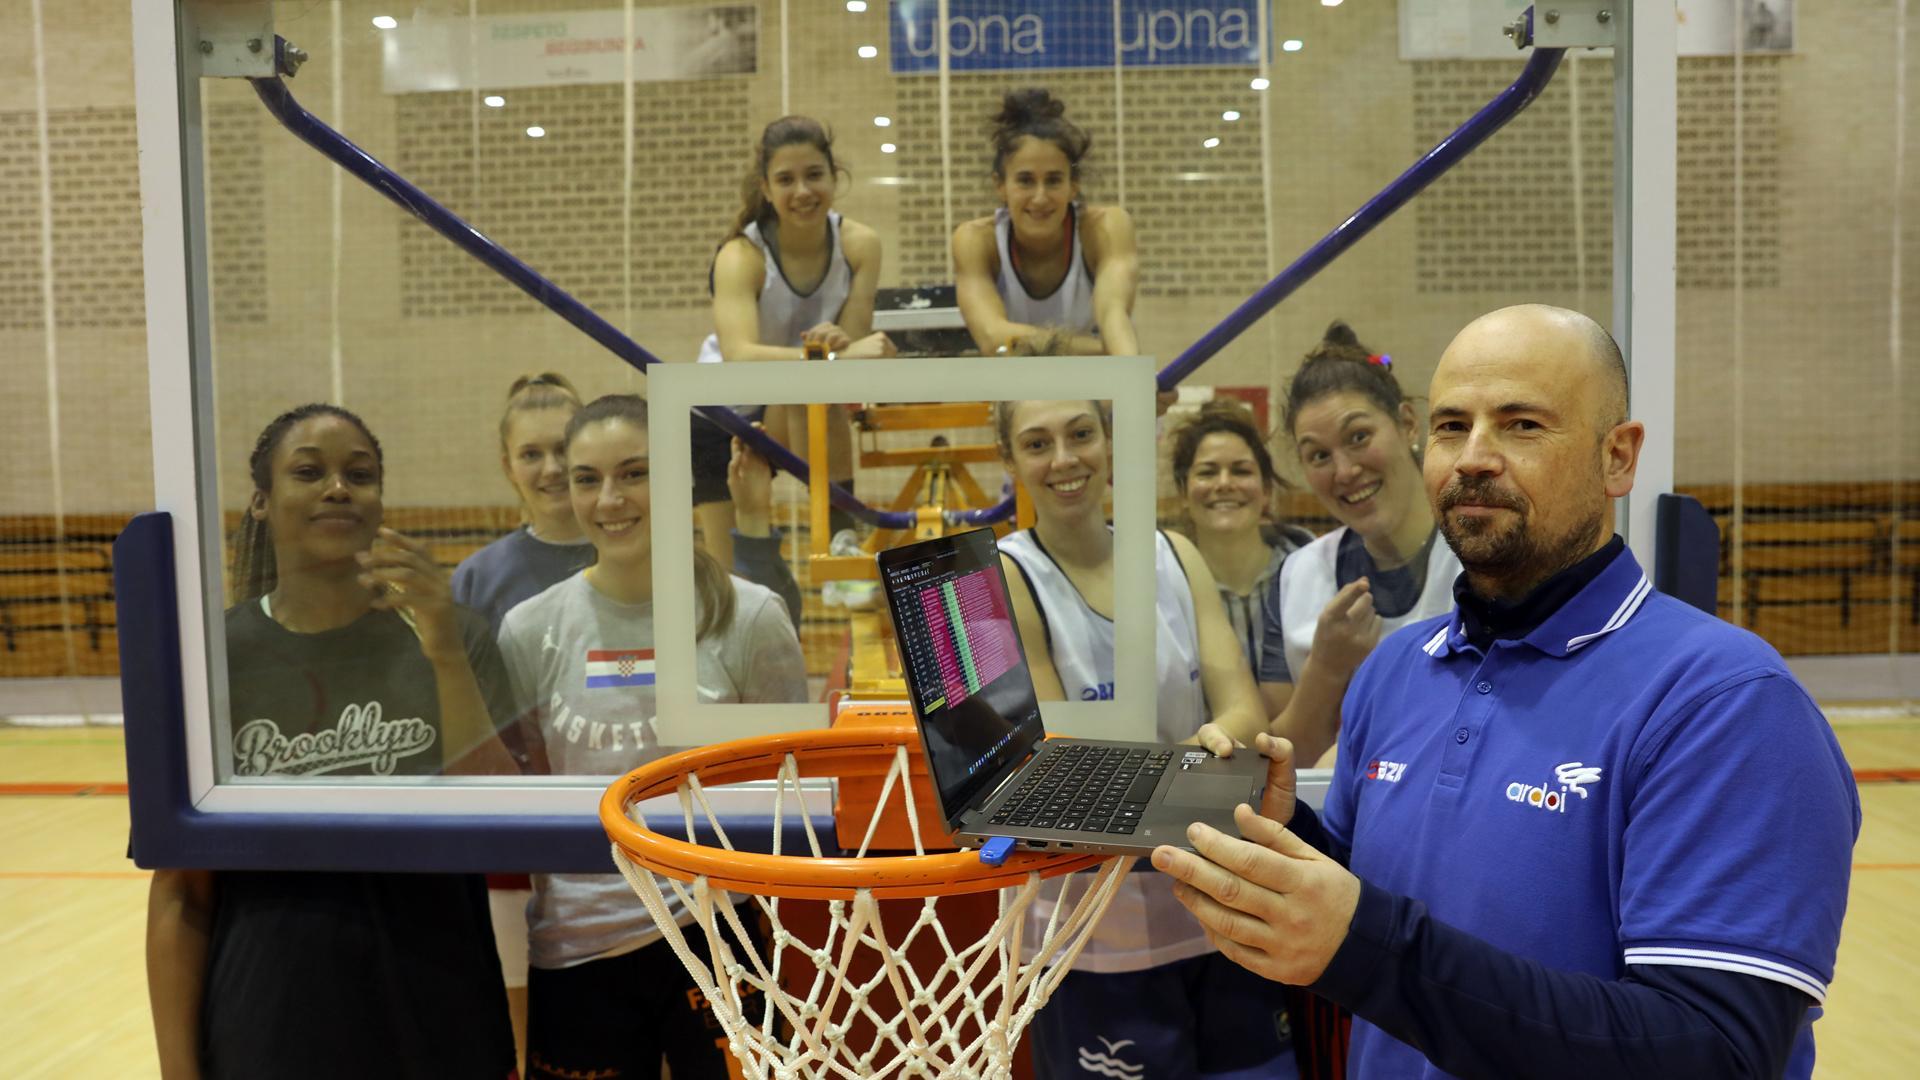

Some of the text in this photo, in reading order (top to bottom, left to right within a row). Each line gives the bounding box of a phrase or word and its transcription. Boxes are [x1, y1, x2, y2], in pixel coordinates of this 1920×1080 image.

[1119, 7, 1252, 60] upna
[234, 701, 436, 776] Brooklyn
[1506, 782, 1567, 813] ardoi
